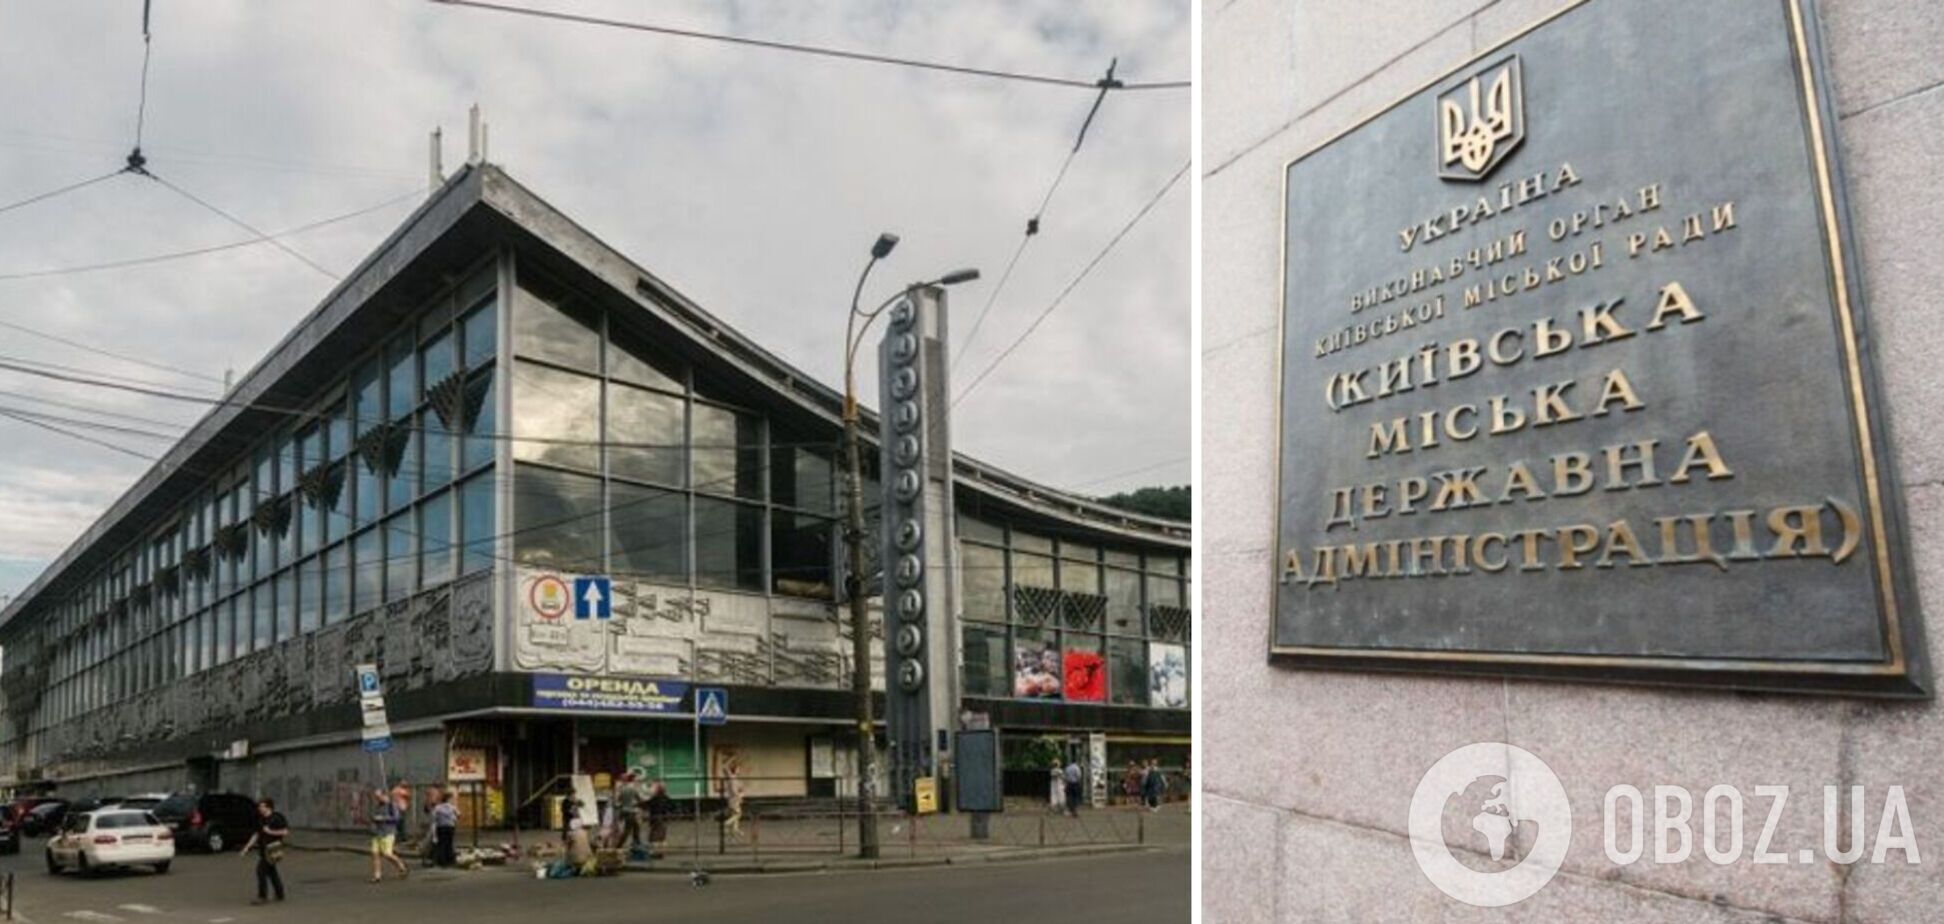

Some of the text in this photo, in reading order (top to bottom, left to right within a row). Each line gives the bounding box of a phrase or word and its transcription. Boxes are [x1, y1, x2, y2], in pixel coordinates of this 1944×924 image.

[1350, 184, 1662, 314] ВИКОНАВЧИЙ ОРГАН
[1400, 162, 1582, 252] УКРАЇНА
[1314, 202, 1738, 359] КИЇВСЬКОЇ МІСЬКОЇ РАДИ
[1325, 280, 1704, 412] (КИЇВСЬКА
[1365, 368, 1645, 458] МІСЬКА
[1325, 431, 1734, 532] ДЕРЖАВНА
[1278, 495, 1862, 589] АДМІНІСТРАЦІЯ)
[566, 677, 659, 694] ОРЕНДА
